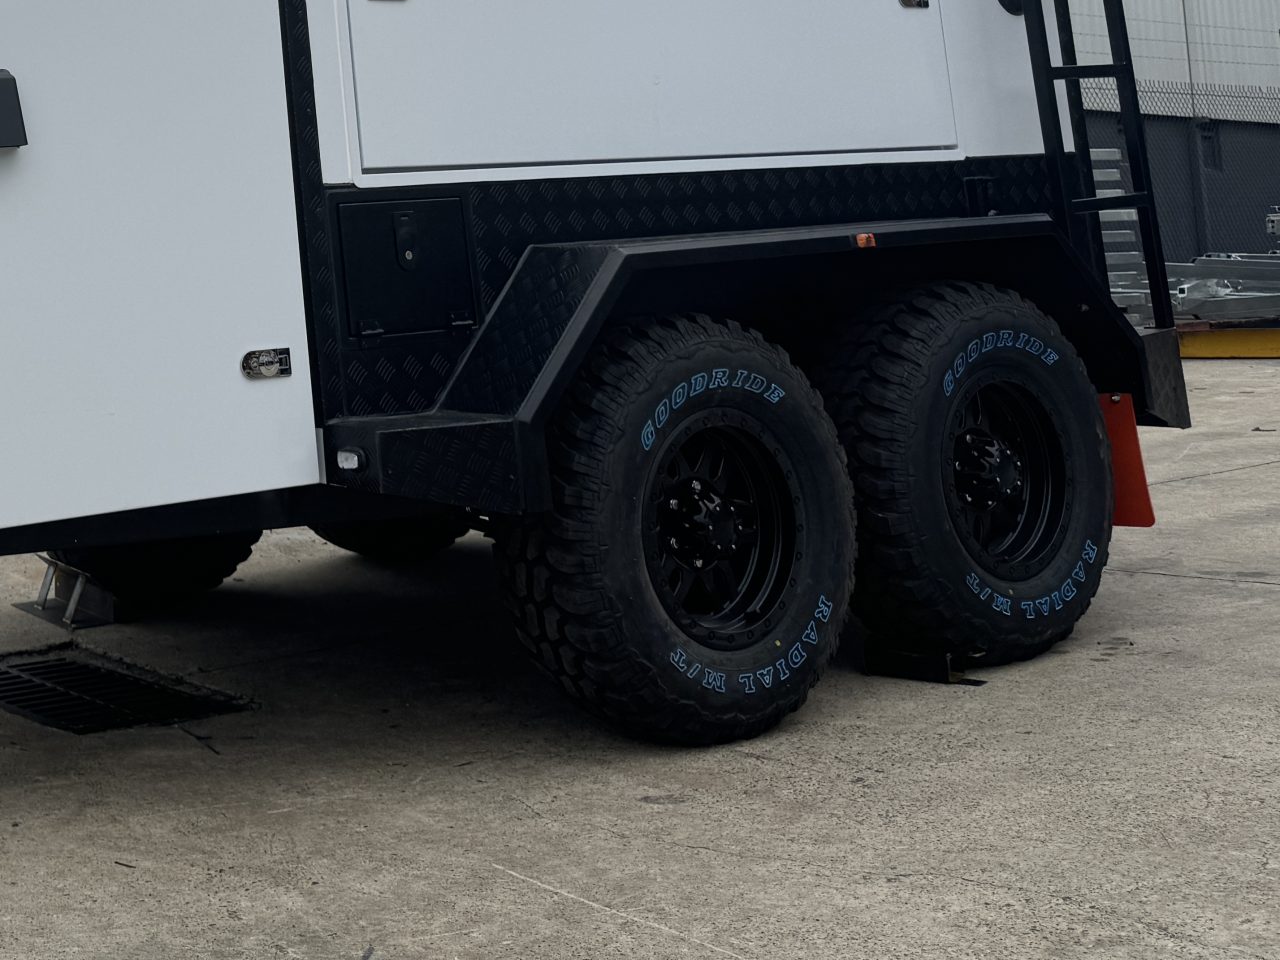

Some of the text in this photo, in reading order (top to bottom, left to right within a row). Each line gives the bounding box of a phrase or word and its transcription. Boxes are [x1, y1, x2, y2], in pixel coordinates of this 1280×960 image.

[942, 330, 1060, 399] GOODRIDE
[640, 368, 786, 451] GOODRIDE
[966, 540, 1099, 619] RADIAL M/T
[670, 594, 834, 694] RADIAL M/T
